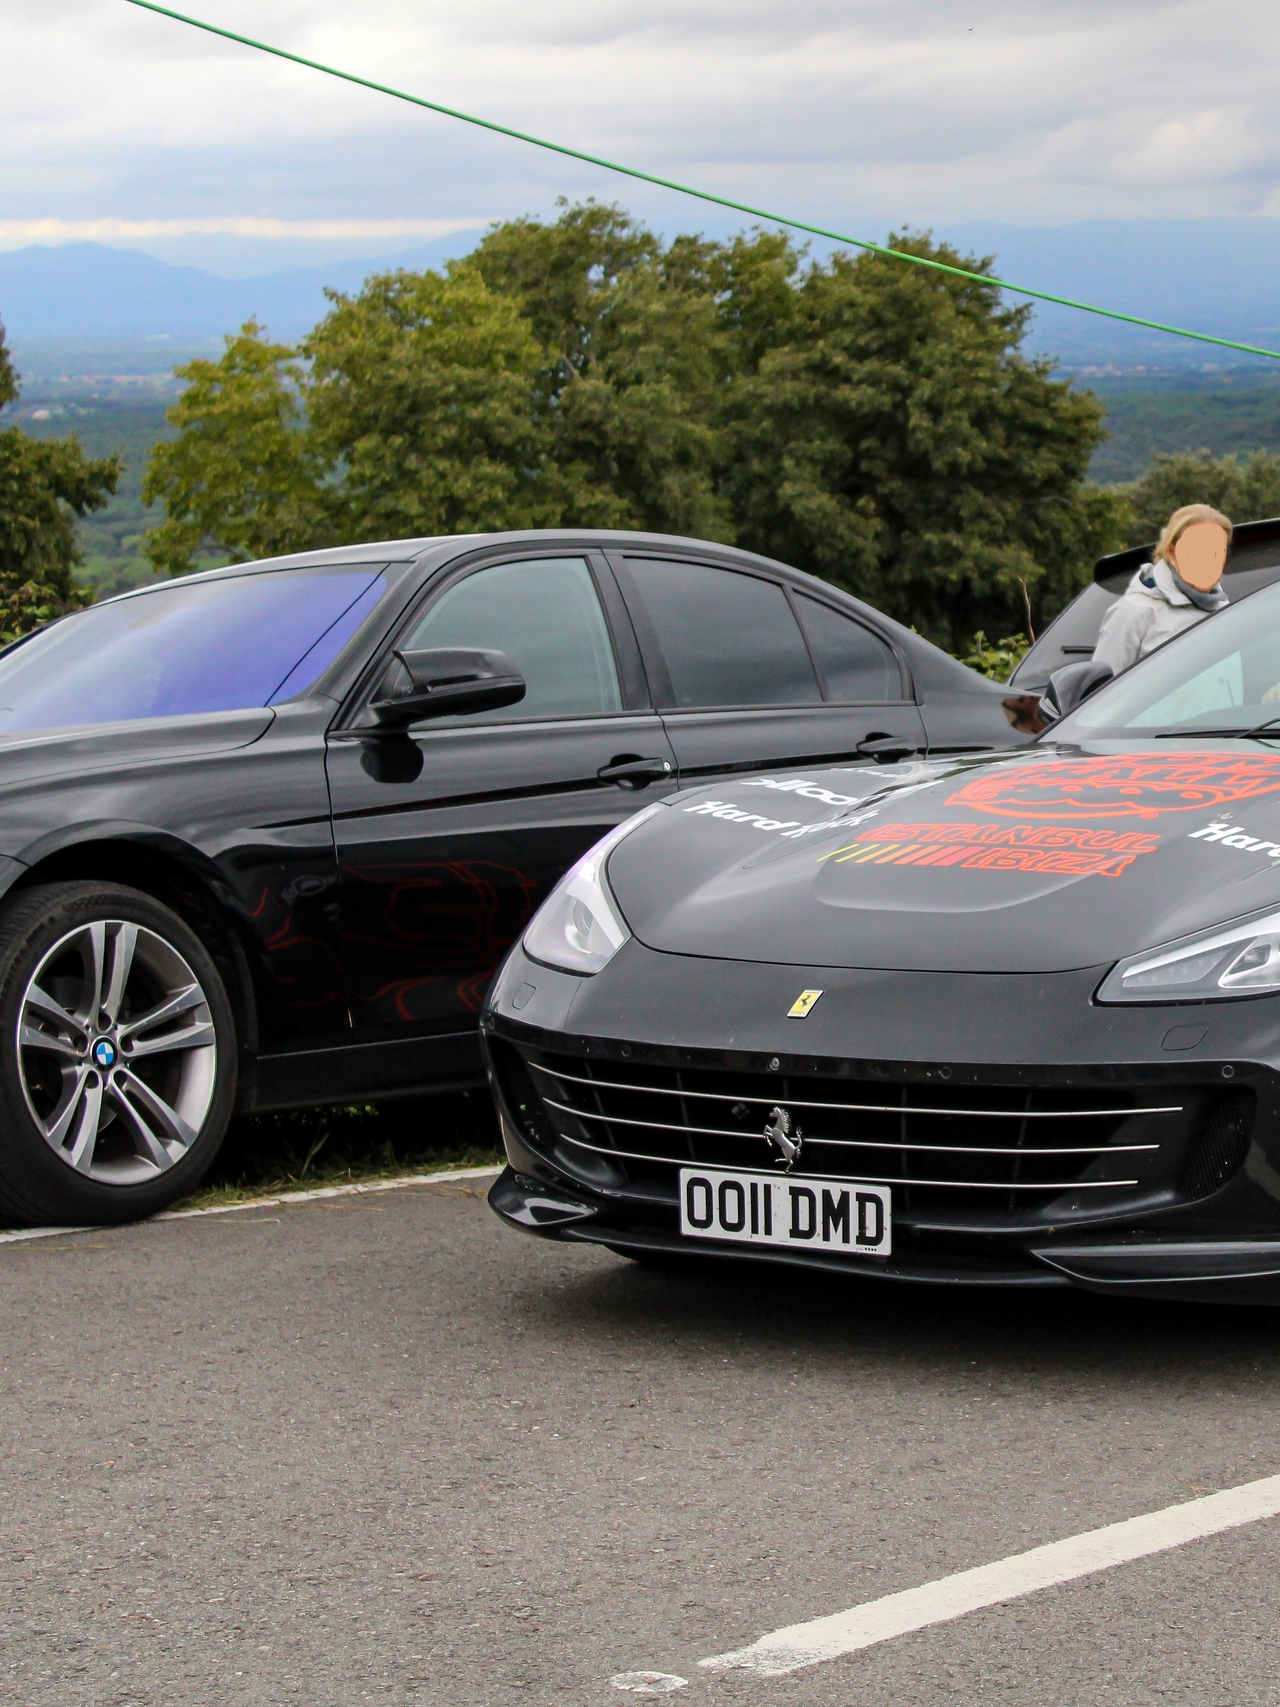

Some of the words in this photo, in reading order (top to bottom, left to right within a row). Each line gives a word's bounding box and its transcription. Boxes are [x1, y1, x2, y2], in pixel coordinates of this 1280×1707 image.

[683, 801, 802, 832] Hard
[853, 823, 1162, 853] ISTANBUL
[960, 847, 1137, 877] IBIZA
[789, 1185, 884, 1247] DMD
